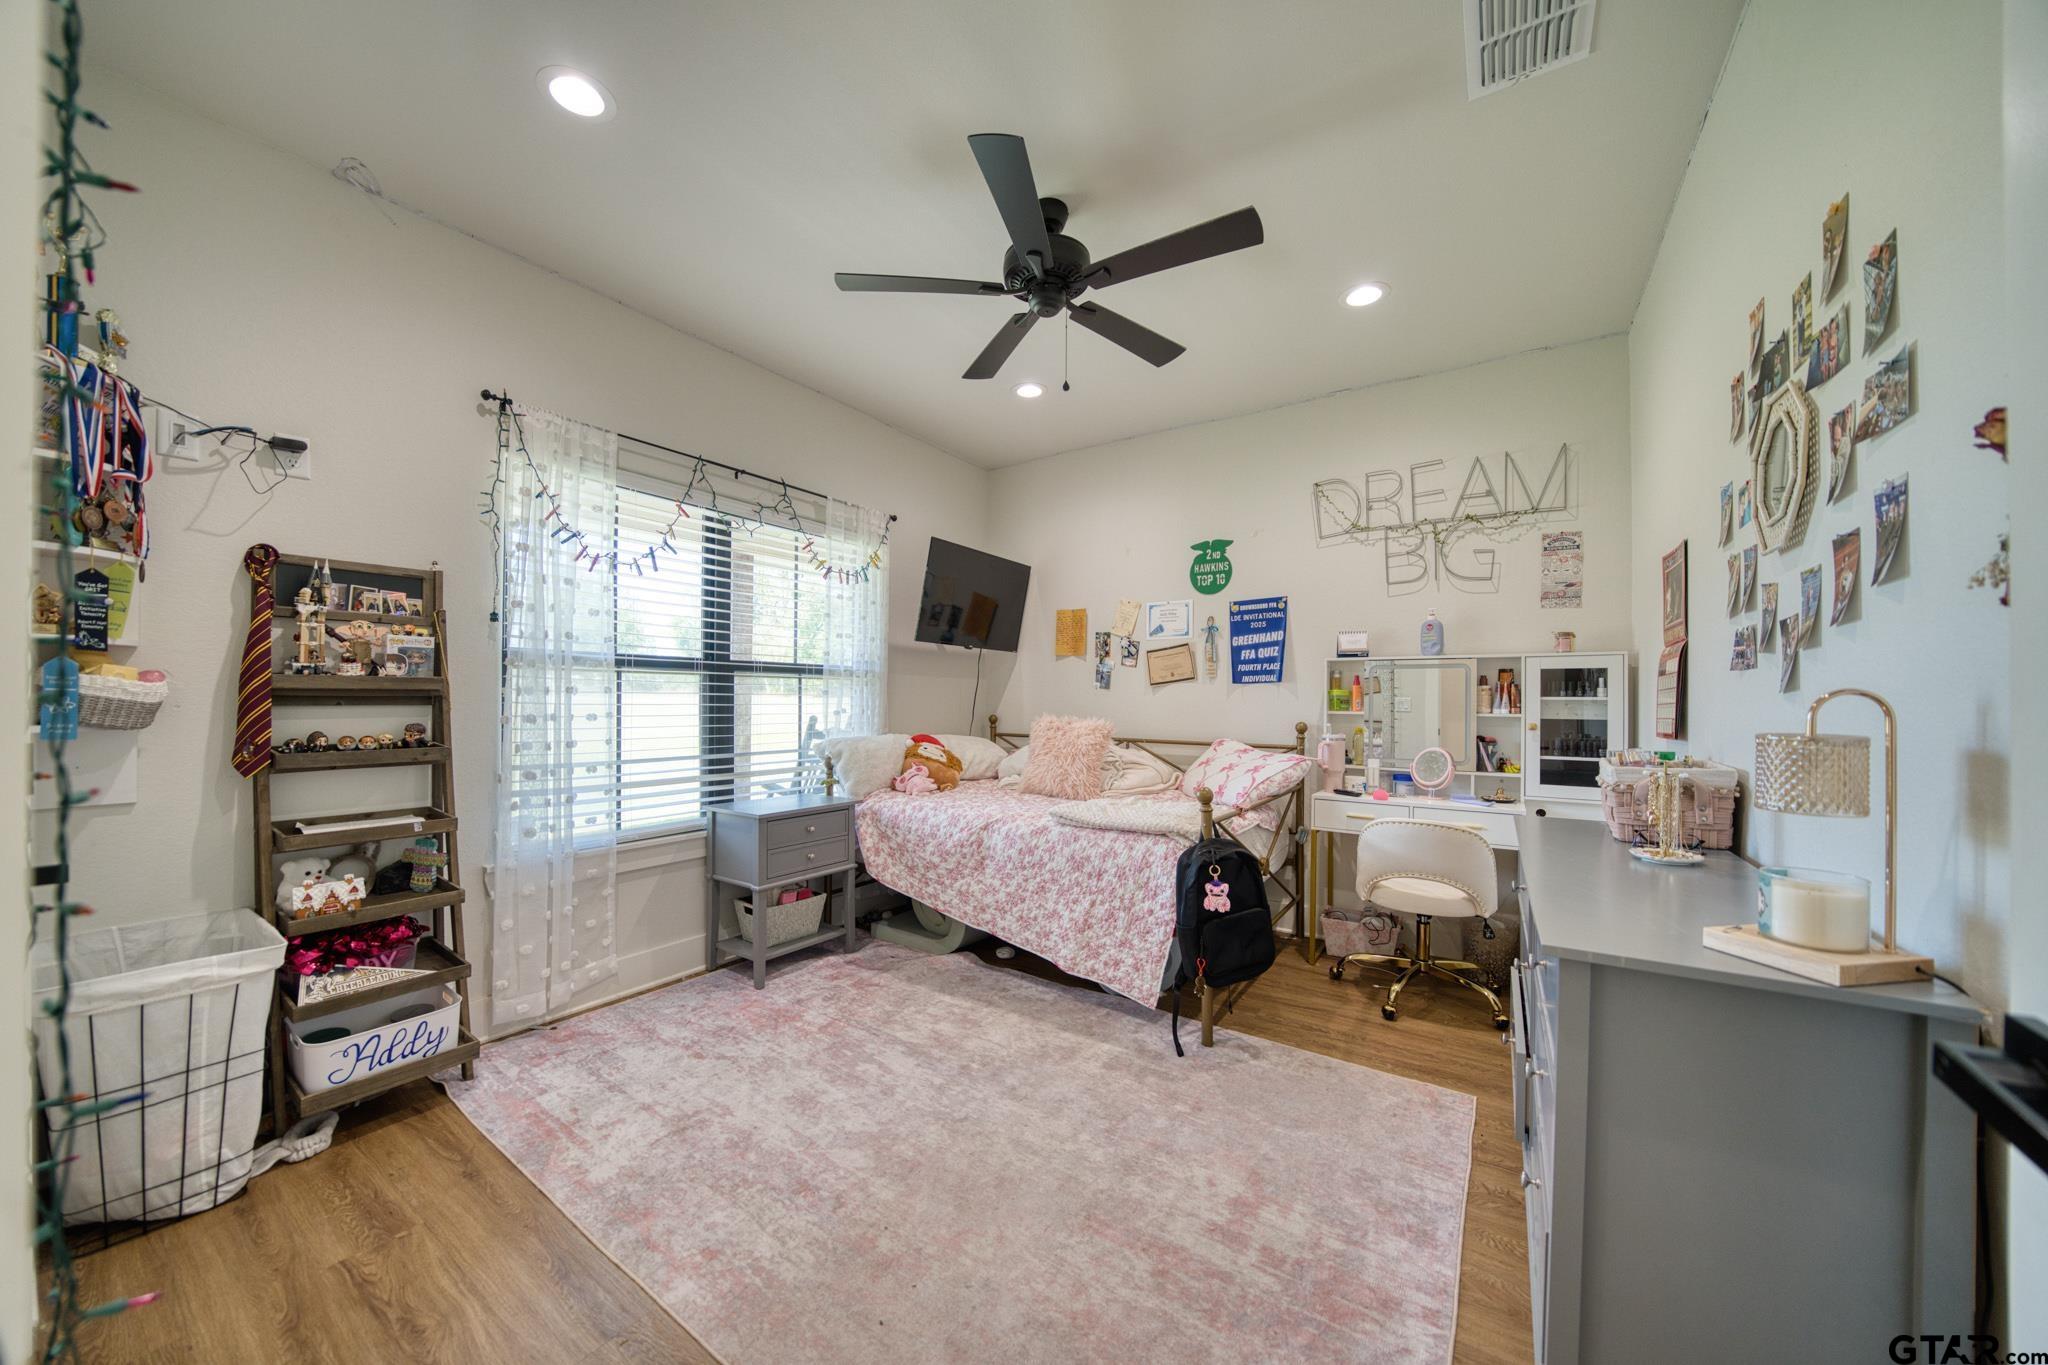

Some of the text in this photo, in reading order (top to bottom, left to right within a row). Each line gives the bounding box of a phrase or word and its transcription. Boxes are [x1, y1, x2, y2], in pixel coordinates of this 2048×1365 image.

[1312, 442, 1568, 540] DREAM
[1384, 520, 1496, 586] BIG
[1194, 561, 1230, 573] HAWKINS
[1197, 573, 1226, 586] TOP 10
[1242, 611, 1285, 621] INVITATIONAL
[1250, 621, 1267, 629] 2025
[1232, 630, 1285, 647] GREENHAND
[1240, 646, 1280, 660] FFA QUIZ
[1237, 662, 1281, 672] FOURTH PLACE
[1241, 674, 1279, 683] INDIVIDUAL
[328, 969, 406, 995] CHEERLEADING
[327, 1020, 450, 1085] Addy
